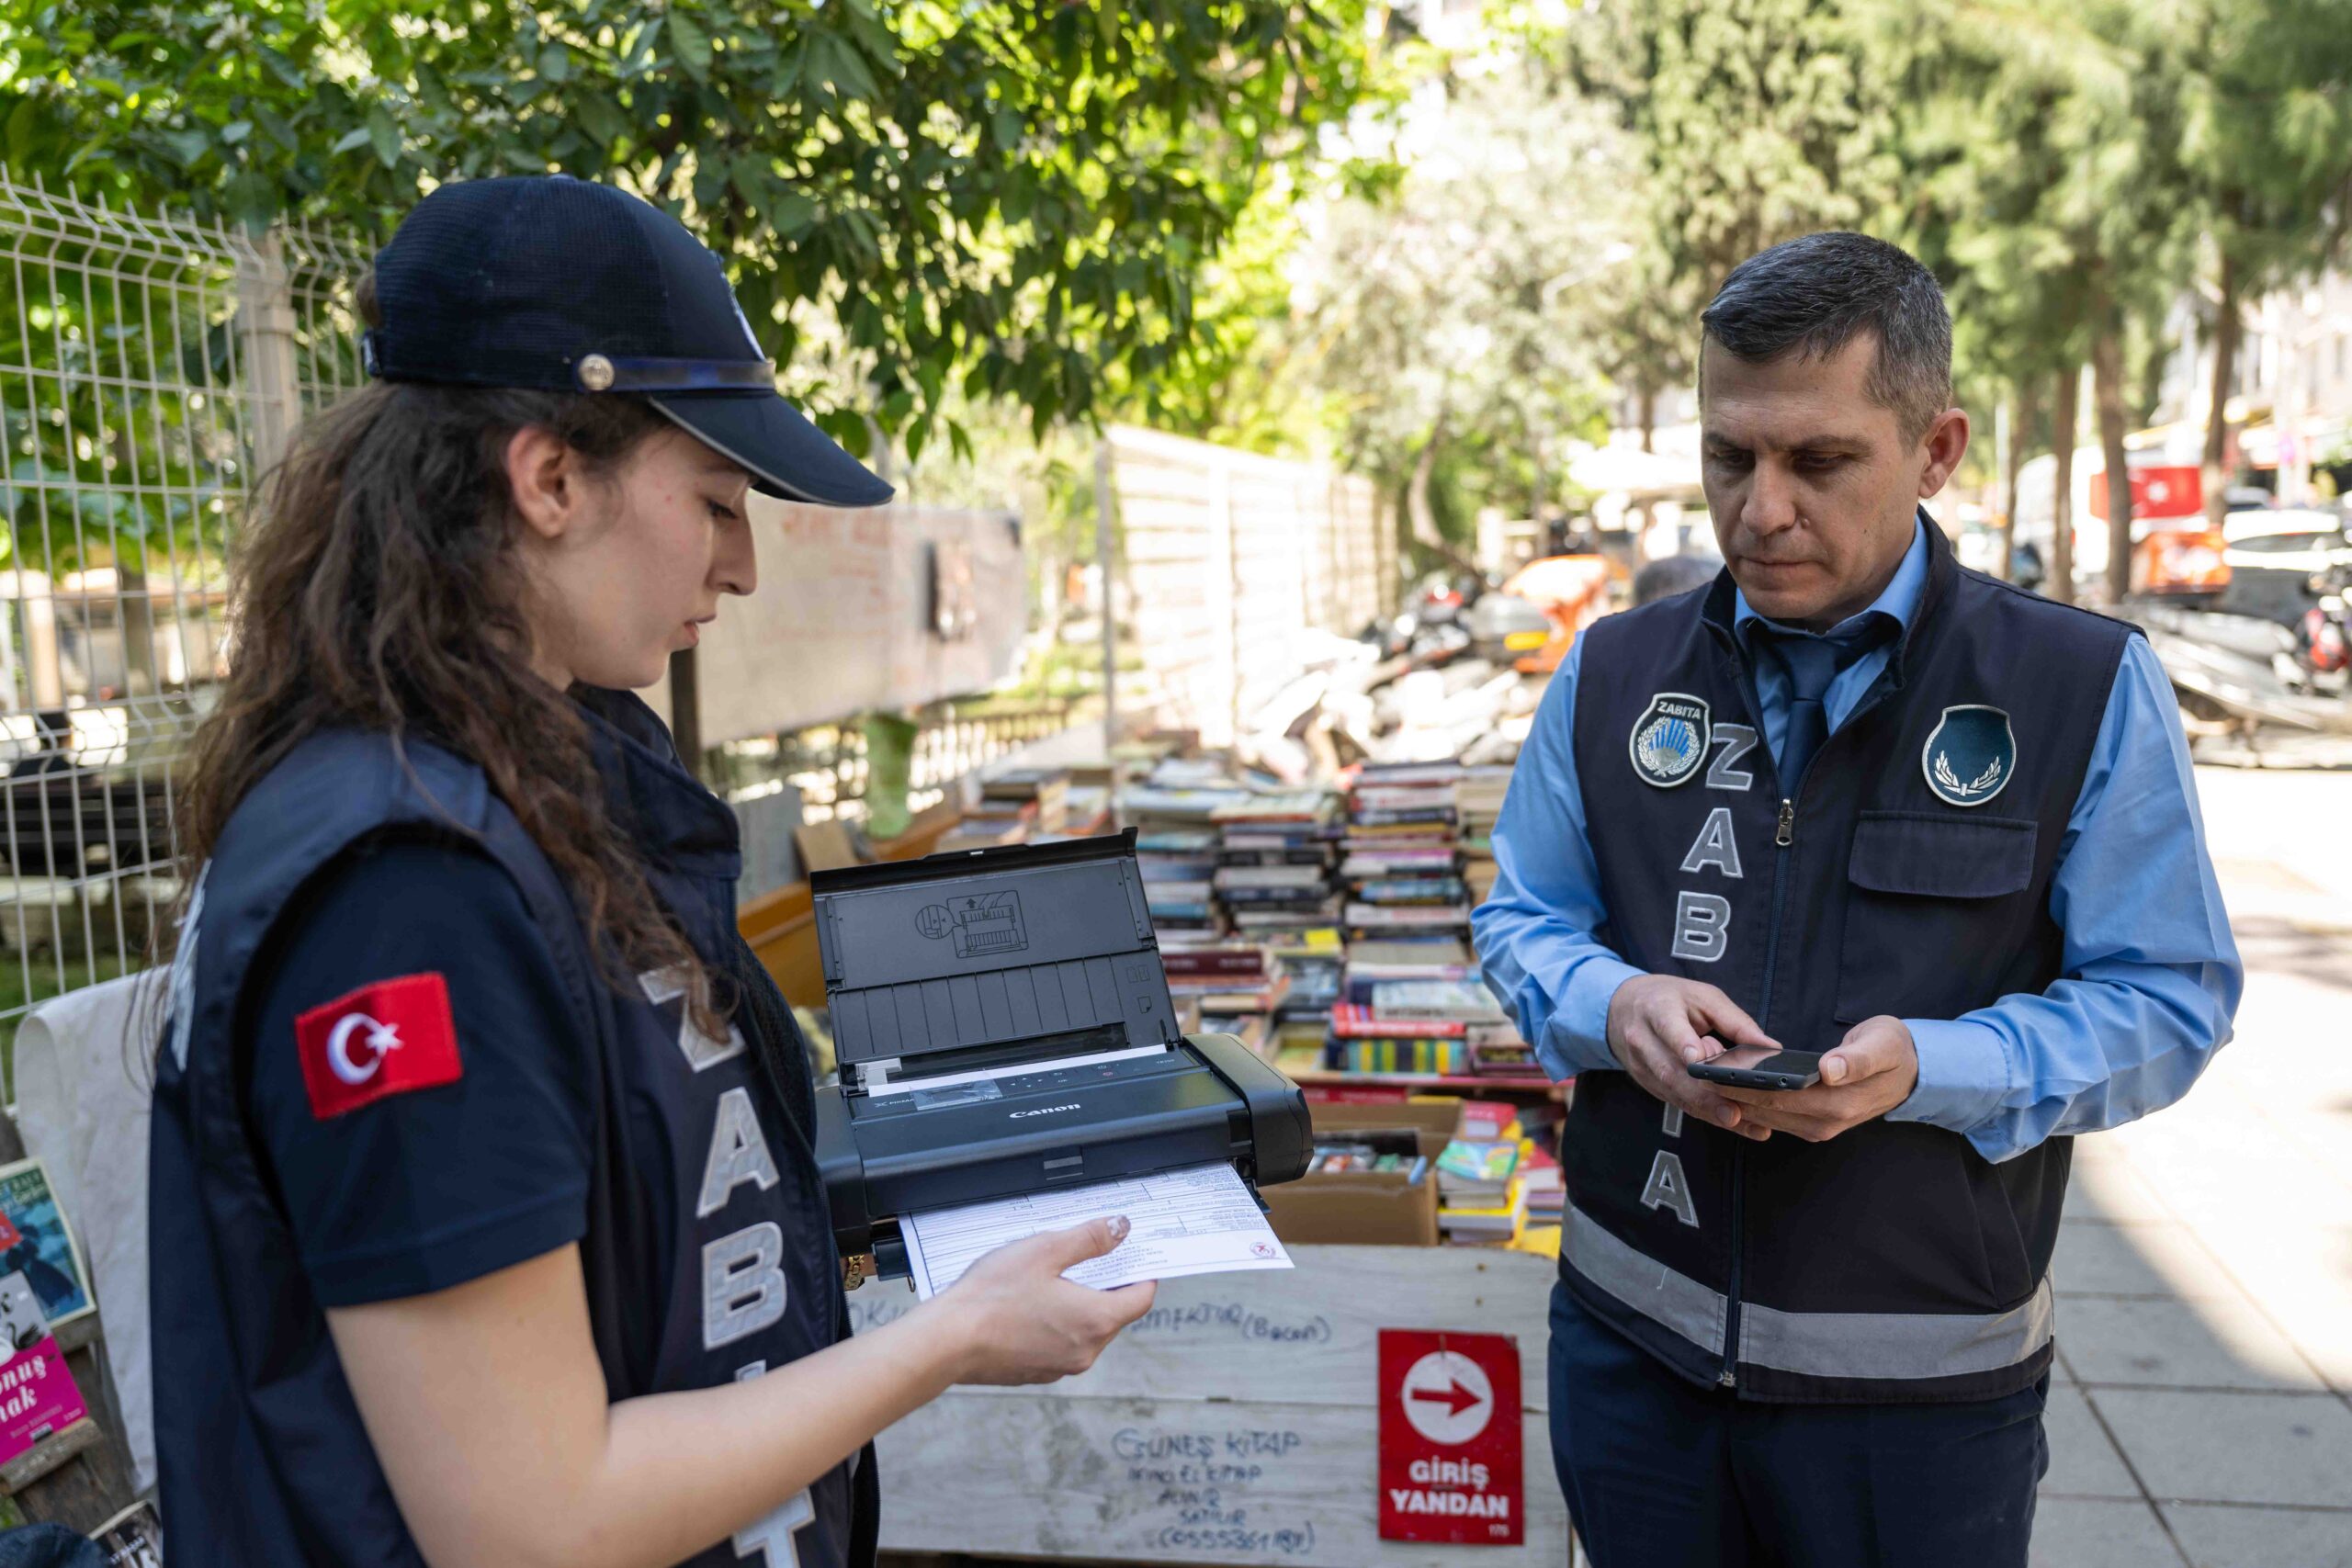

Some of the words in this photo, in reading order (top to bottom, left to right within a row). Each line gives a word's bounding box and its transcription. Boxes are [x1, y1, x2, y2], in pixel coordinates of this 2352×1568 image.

[1657, 701, 1701, 720] ZABITA
[1639, 722, 1758, 1228] ZABA
[1009, 1102, 1081, 1119] Canon
[1408, 1455, 1490, 1492] GİRİŞ
[1389, 1488, 1510, 1518] YANDAN
